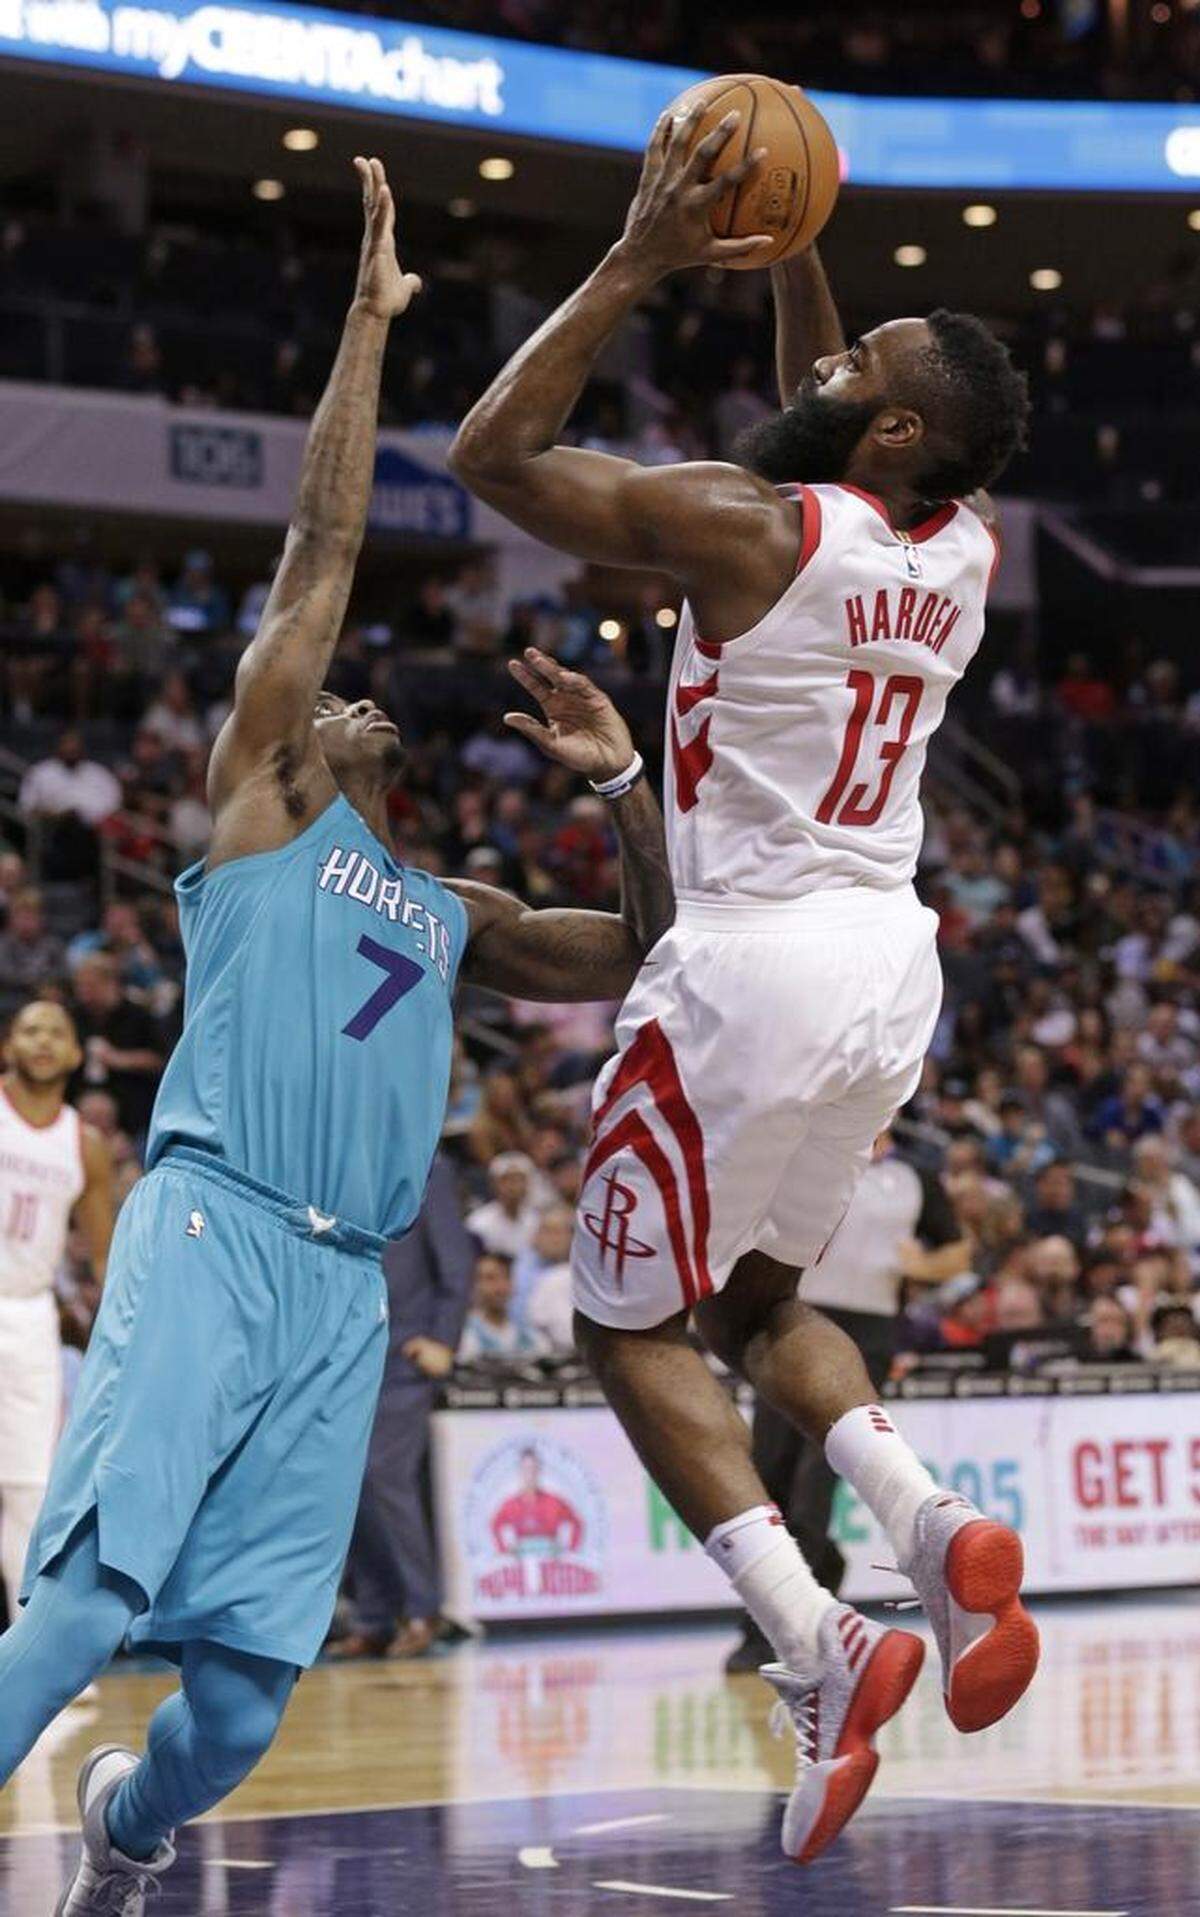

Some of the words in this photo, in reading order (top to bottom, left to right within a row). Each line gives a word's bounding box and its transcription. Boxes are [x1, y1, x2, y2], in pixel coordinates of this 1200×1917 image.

[845, 587, 961, 655] HARDEN
[814, 669, 925, 827] 13
[341, 933, 426, 1041] 7
[1073, 1439, 1170, 1508] GET
